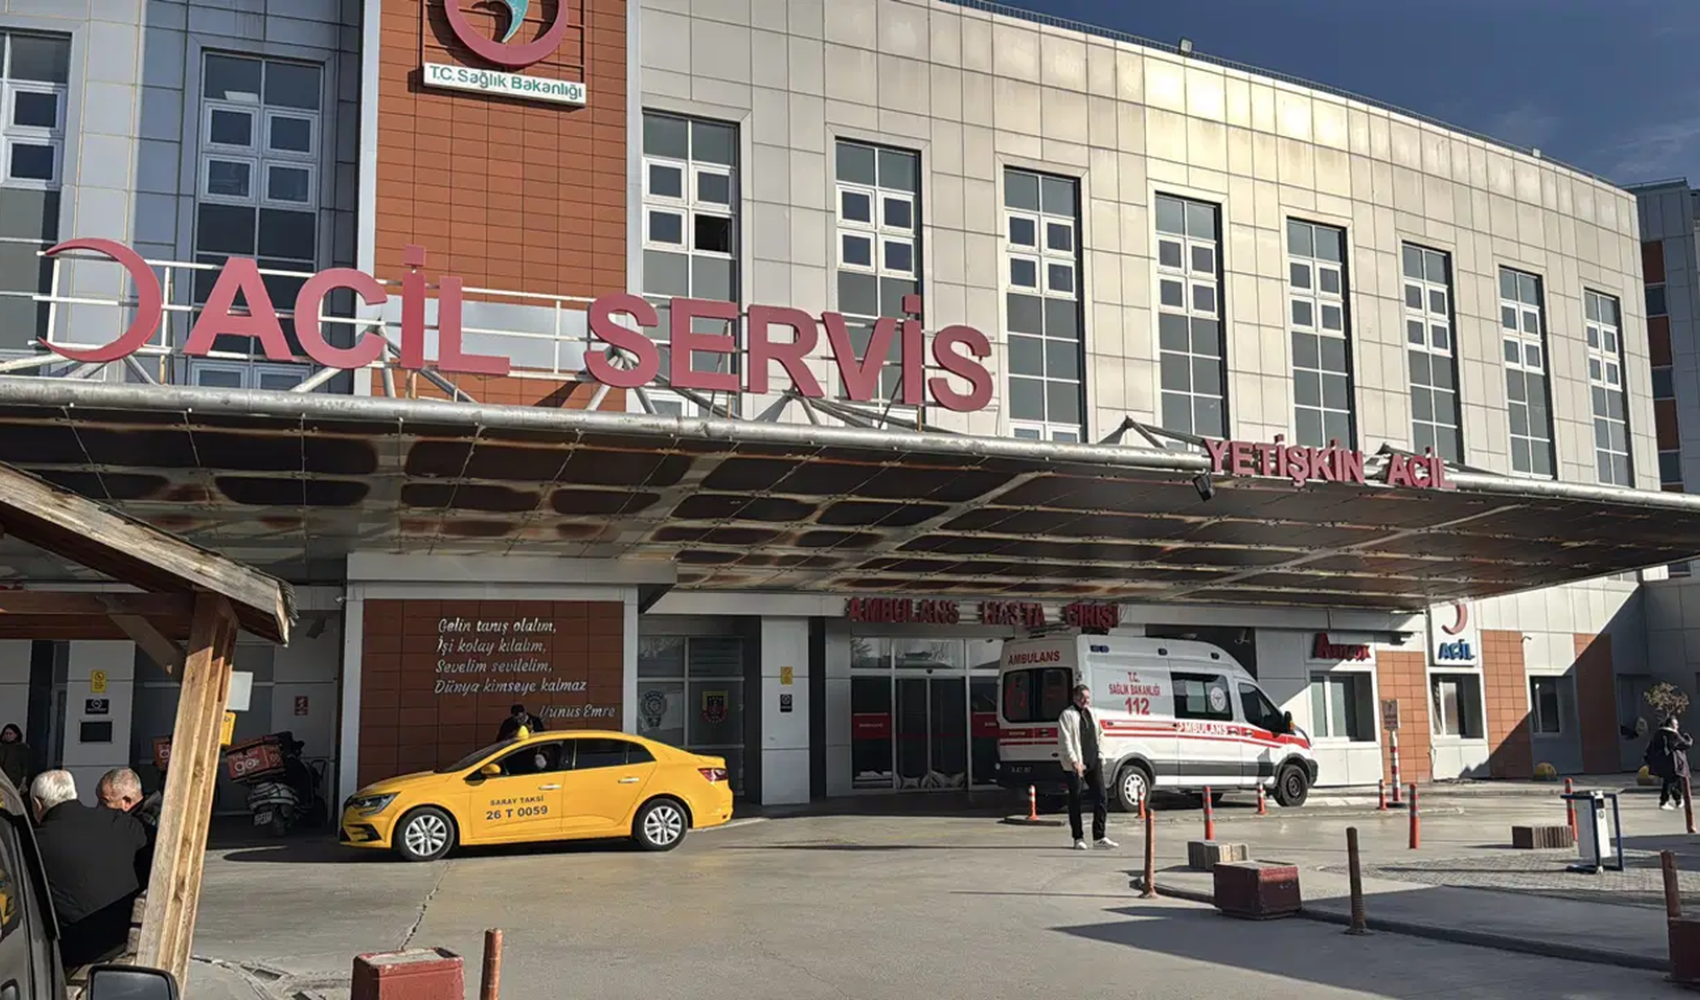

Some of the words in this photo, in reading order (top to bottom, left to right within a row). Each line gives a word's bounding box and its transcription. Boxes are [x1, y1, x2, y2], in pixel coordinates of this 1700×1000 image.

[429, 65, 455, 81] T.C.
[457, 69, 507, 88] Sağlık
[511, 77, 583, 100] Bakanlığı
[183, 244, 511, 375] ACİL
[583, 293, 994, 412] SERVİS
[1203, 434, 1366, 486] YETİŞKİN
[1386, 446, 1457, 490] ACİL
[846, 598, 960, 625] AMBULANS
[979, 601, 1046, 628] HASTA
[438, 617, 471, 633] Gelin
[476, 618, 509, 635] tanış
[513, 617, 557, 634] olalım,
[436, 636, 454, 656] İşi
[458, 637, 496, 655] kolay
[498, 639, 547, 654] kılalım,
[1437, 638, 1476, 661] ACİL
[435, 658, 487, 674] Sevelim
[491, 658, 553, 673] sevilelim,
[1008, 650, 1061, 666] AMBULANS
[1127, 671, 1141, 683] T.C.
[434, 679, 480, 696] Dünya
[483, 677, 536, 696] kimseye
[540, 677, 588, 692] kalmaz
[1108, 682, 1129, 696] SAĞLIK
[1130, 683, 1161, 697] BAKANLIĞI
[538, 704, 581, 722] Yunus
[582, 703, 616, 718] Emre
[1125, 697, 1150, 715] 112
[490, 798, 517, 806] SARAY
[486, 809, 502, 820] 26
[505, 808, 514, 819] T
[517, 804, 549, 818] 0059
